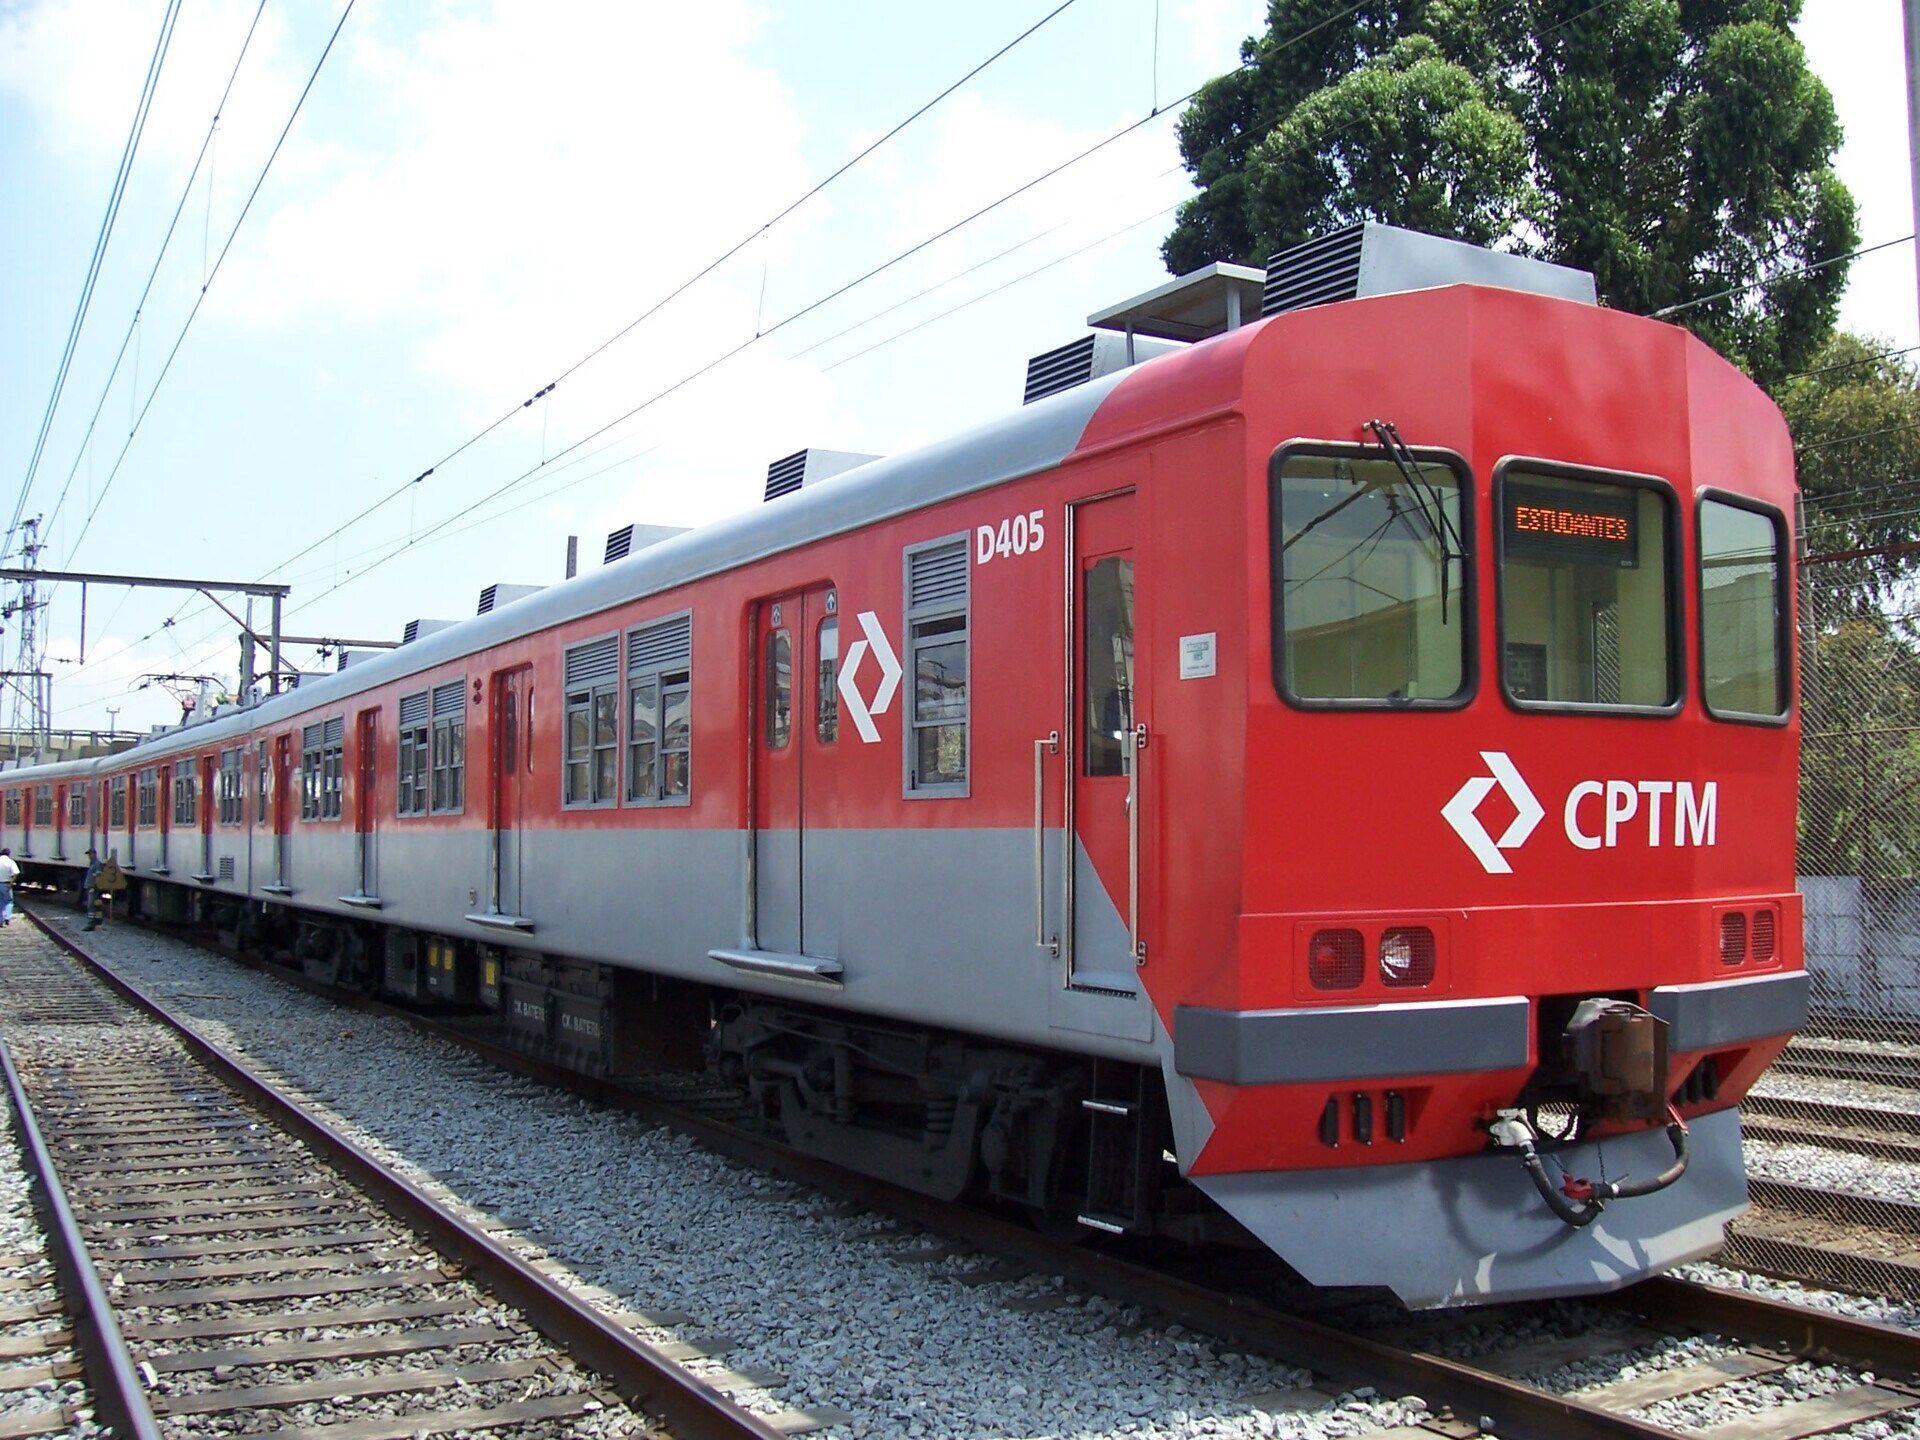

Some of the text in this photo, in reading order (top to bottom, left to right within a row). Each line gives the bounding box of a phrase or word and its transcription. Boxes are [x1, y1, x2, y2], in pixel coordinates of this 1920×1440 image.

[976, 509, 1045, 565] D405
[1515, 506, 1628, 540] ESTUDANTES
[1564, 780, 1718, 850] CPTM
